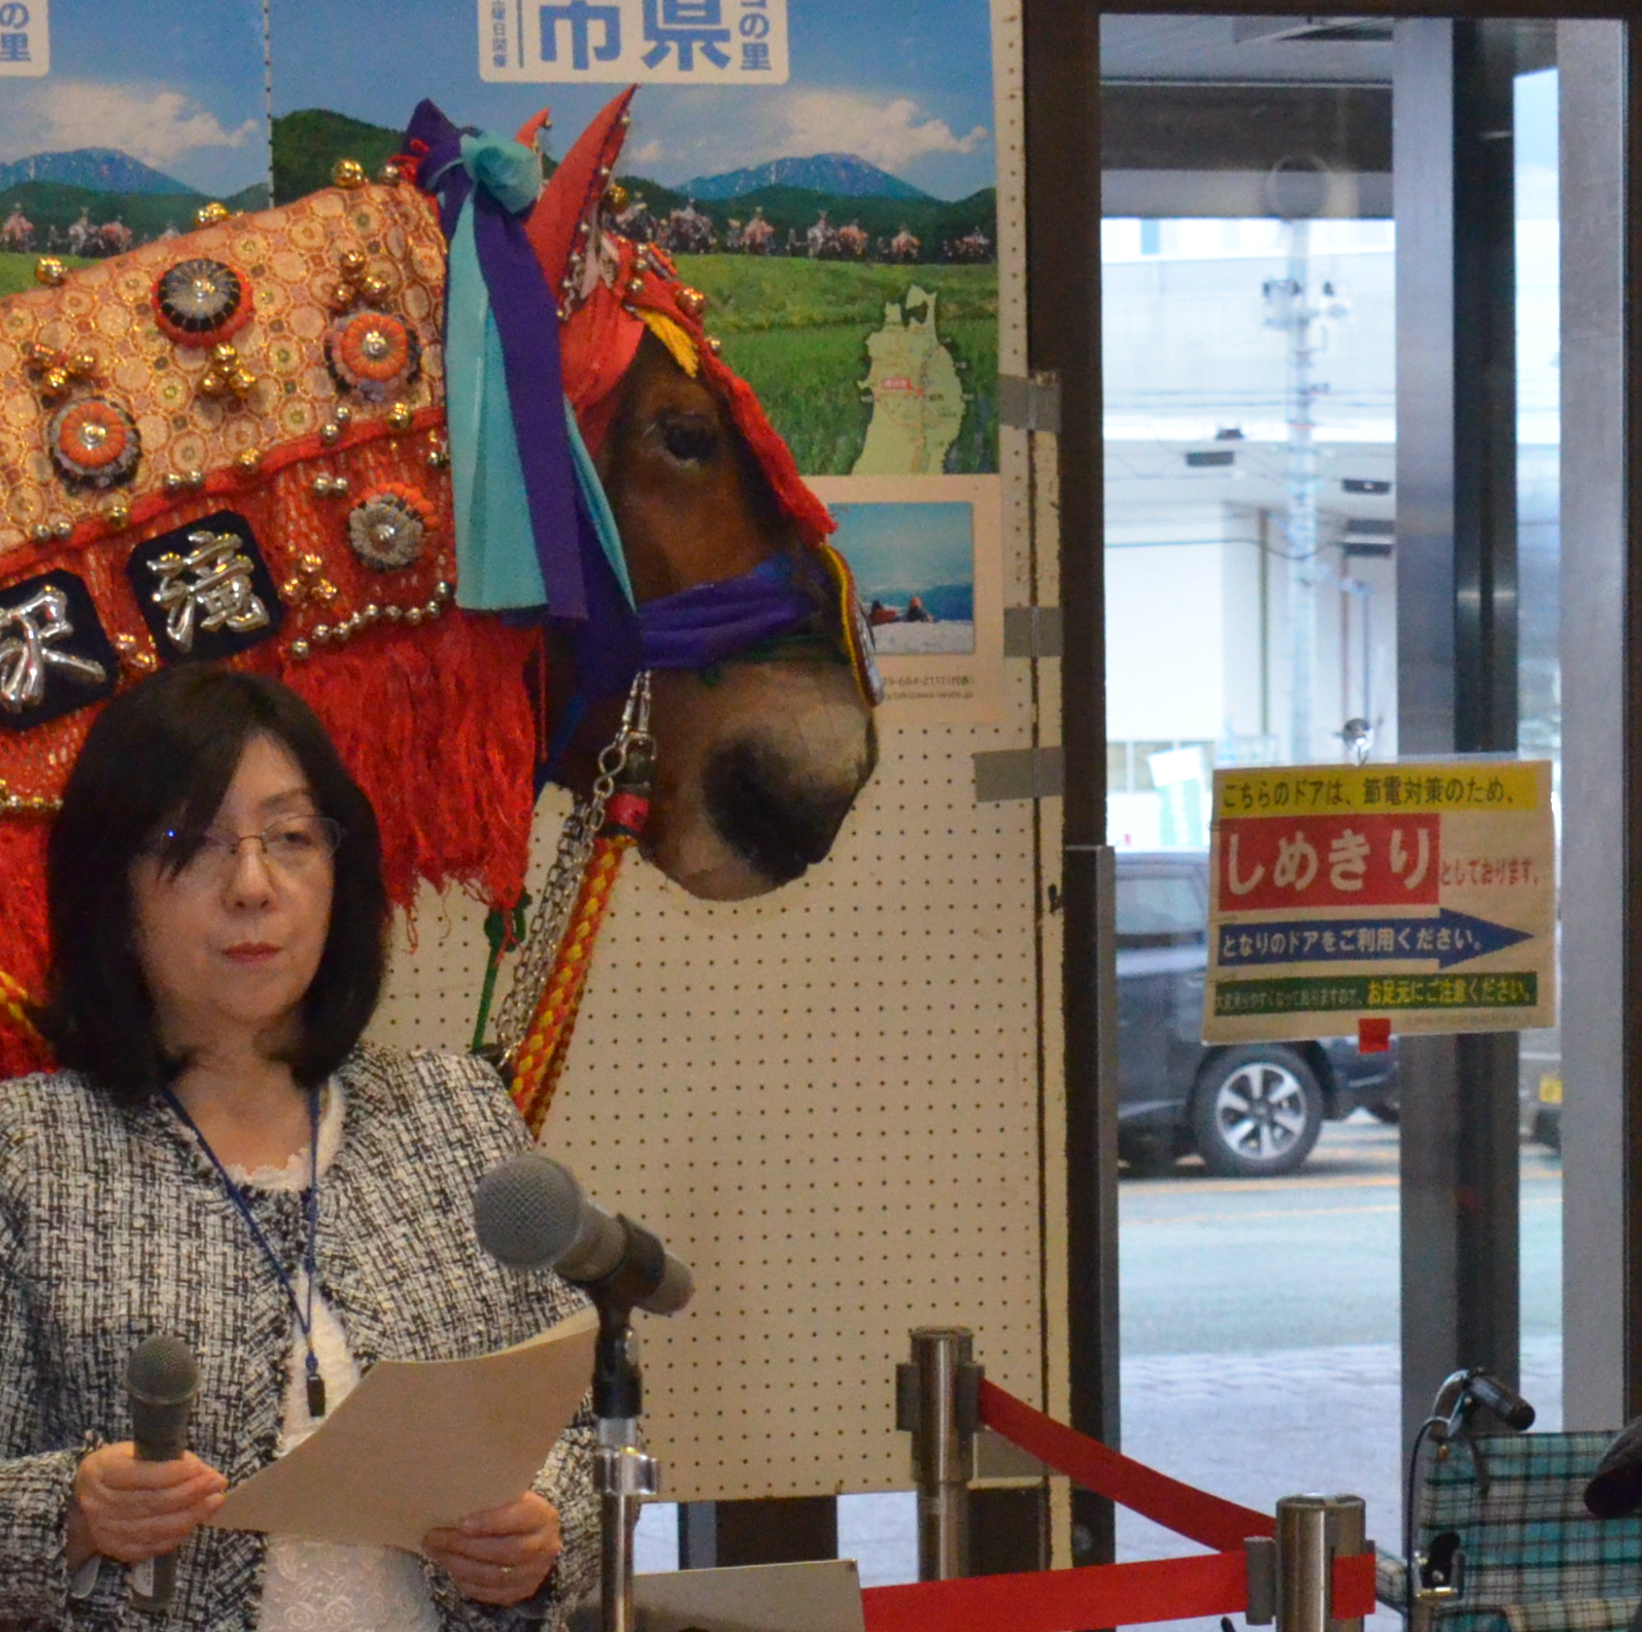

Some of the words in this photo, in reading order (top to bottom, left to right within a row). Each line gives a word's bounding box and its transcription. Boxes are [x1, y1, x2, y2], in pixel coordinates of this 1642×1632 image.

[539, 0, 623, 71] 市
[641, 0, 732, 71] 県
[1227, 828, 1433, 897] しめきり
[1221, 927, 1483, 959] となりのドアをご利用ください。
